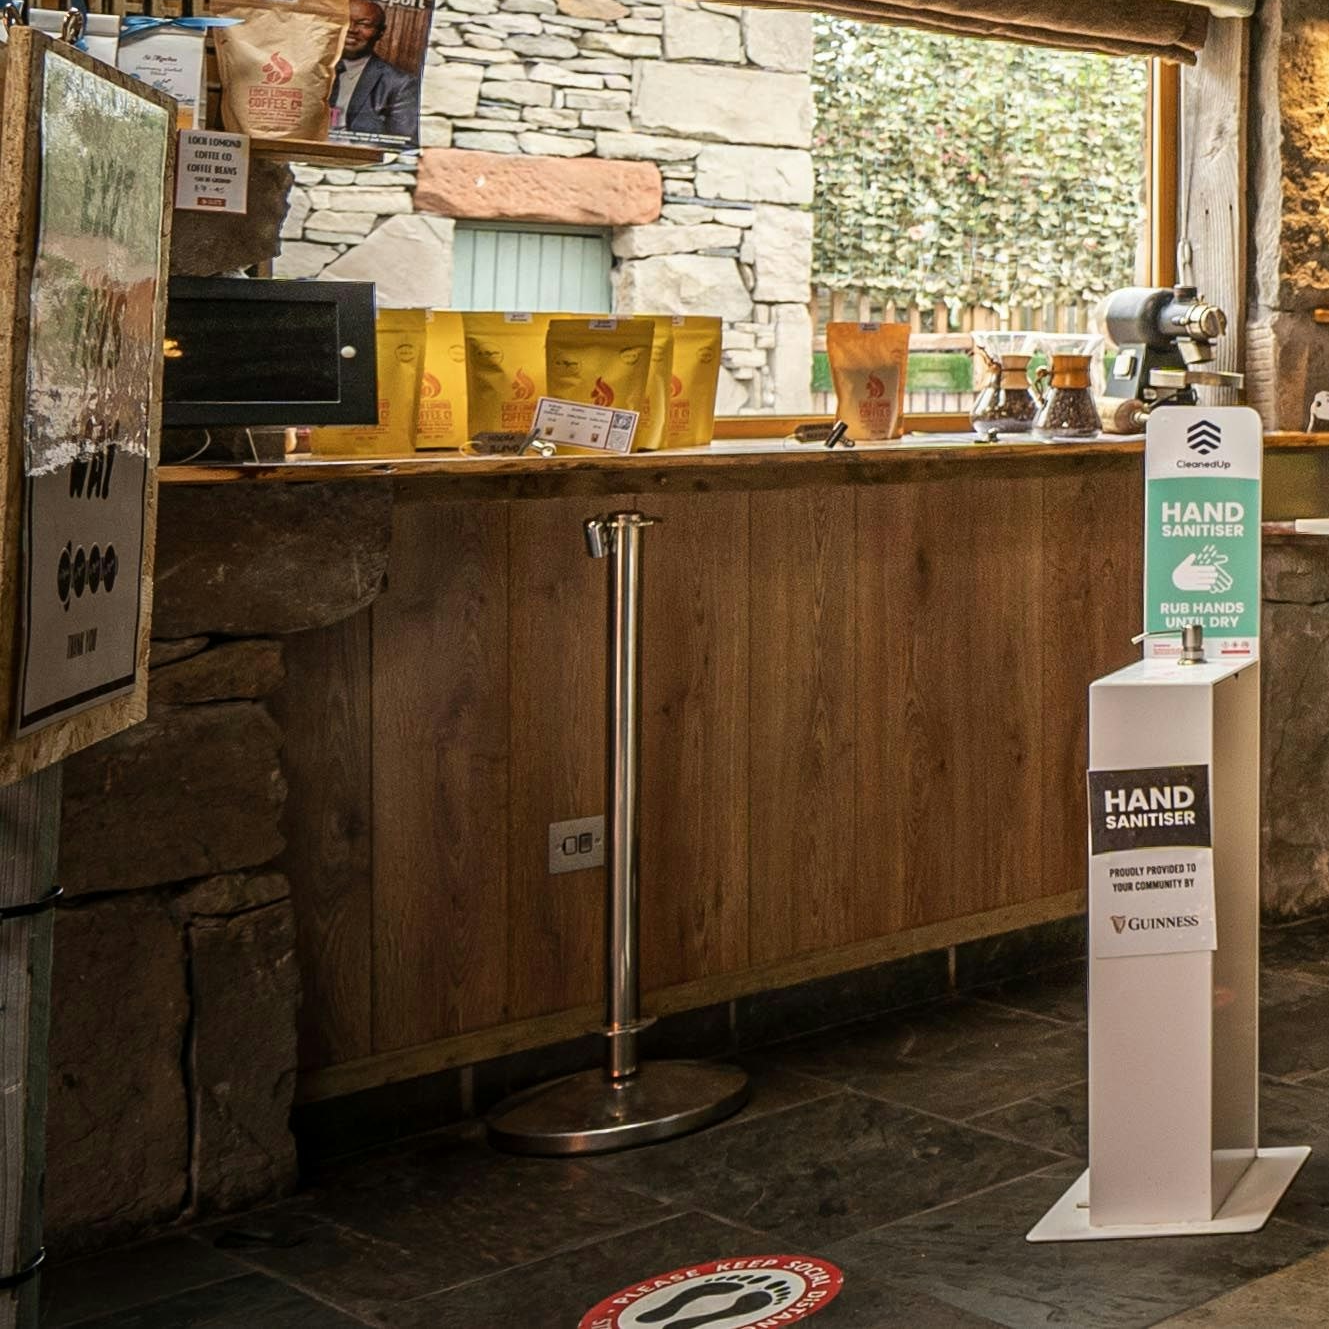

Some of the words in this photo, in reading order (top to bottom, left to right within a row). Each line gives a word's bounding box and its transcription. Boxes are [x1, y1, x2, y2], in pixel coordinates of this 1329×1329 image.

[249, 99, 288, 110] COFFEE
[188, 136, 206, 145] LOCH
[209, 136, 242, 149] LOMOND
[195, 150, 220, 159] COFFEE
[187, 164, 212, 174] COFFEE
[1176, 459, 1231, 470] CleanedUp
[1161, 501, 1245, 523] HAND
[1161, 524, 1245, 538] SANITISER
[1160, 602, 1191, 615] RUB
[1193, 601, 1245, 615] HANDS
[1165, 615, 1204, 628] UNTIL
[1206, 615, 1240, 629] DRY
[1104, 785, 1195, 812] HAND
[1105, 810, 1196, 831] SANITISER
[1109, 866, 1142, 878] PROUDLY
[1145, 864, 1182, 877] PROVIDED
[1185, 863, 1197, 874] TO
[1112, 881, 1133, 893] YOUR
[1135, 878, 1181, 891] COMMUNITY
[1183, 877, 1194, 888] BY
[1128, 915, 1199, 932] GUINNESS
[613, 1269, 701, 1305] PLEASE
[716, 1259, 779, 1272] KEEP
[783, 1260, 831, 1288] SOCIAL
